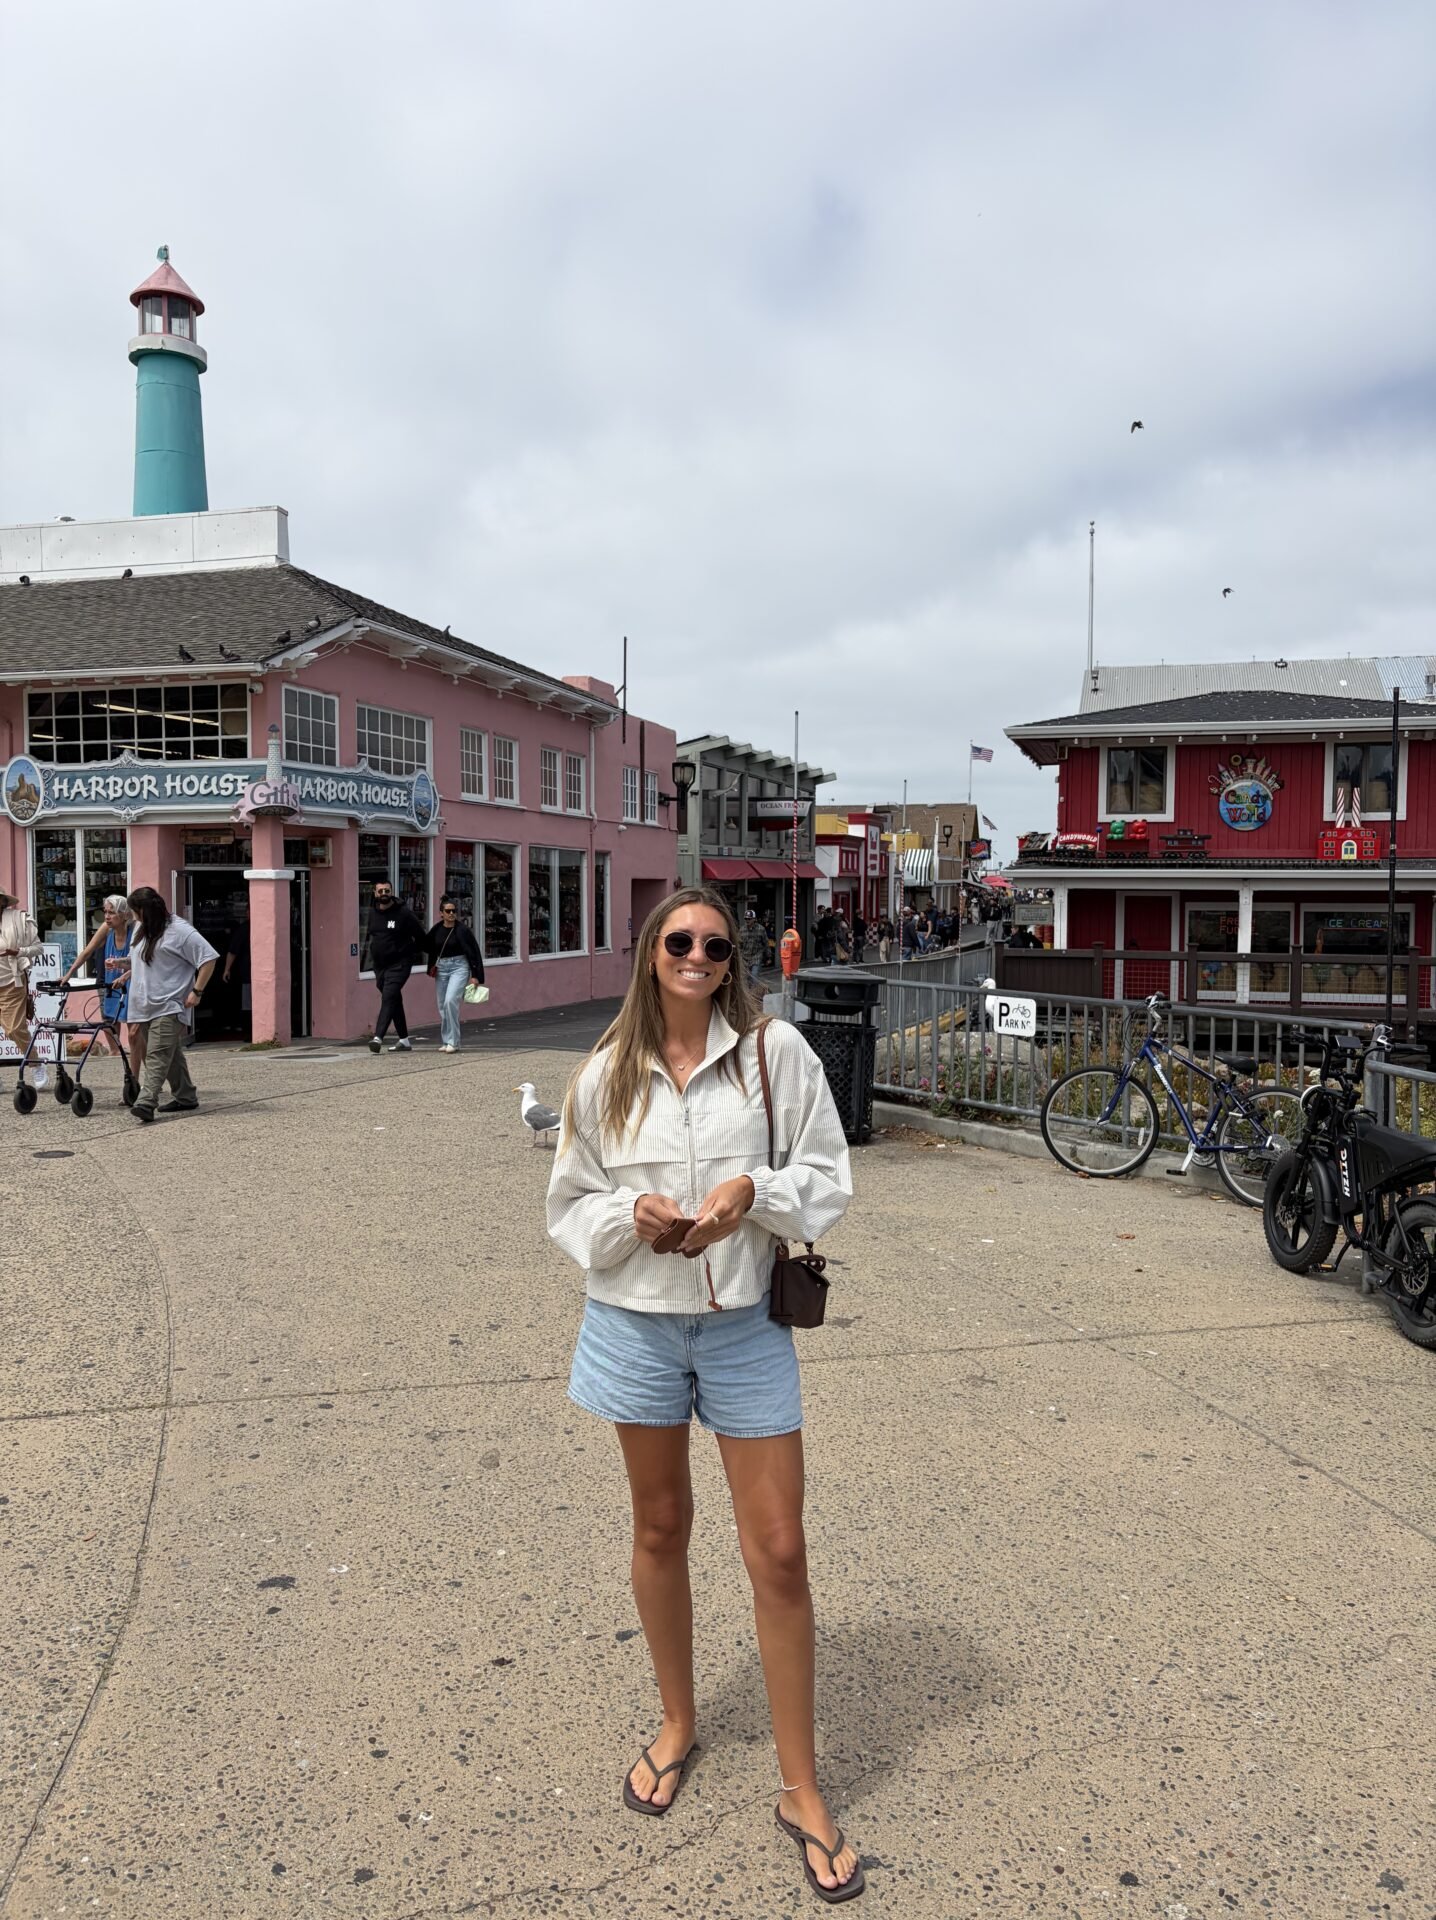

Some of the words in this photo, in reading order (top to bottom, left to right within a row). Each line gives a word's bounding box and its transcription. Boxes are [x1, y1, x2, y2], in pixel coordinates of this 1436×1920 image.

[52, 774, 160, 801] HARBOR
[164, 773, 250, 797] HOUSE
[250, 781, 299, 808] Gifts
[361, 784, 410, 808] HOUSE
[1224, 789, 1269, 808] Candy
[1226, 807, 1267, 823] World
[1059, 833, 1098, 843] CANDYWORLD
[1219, 915, 1256, 926] FREH
[1351, 918, 1389, 928] CREAM
[998, 1002, 1031, 1030] PARKN
